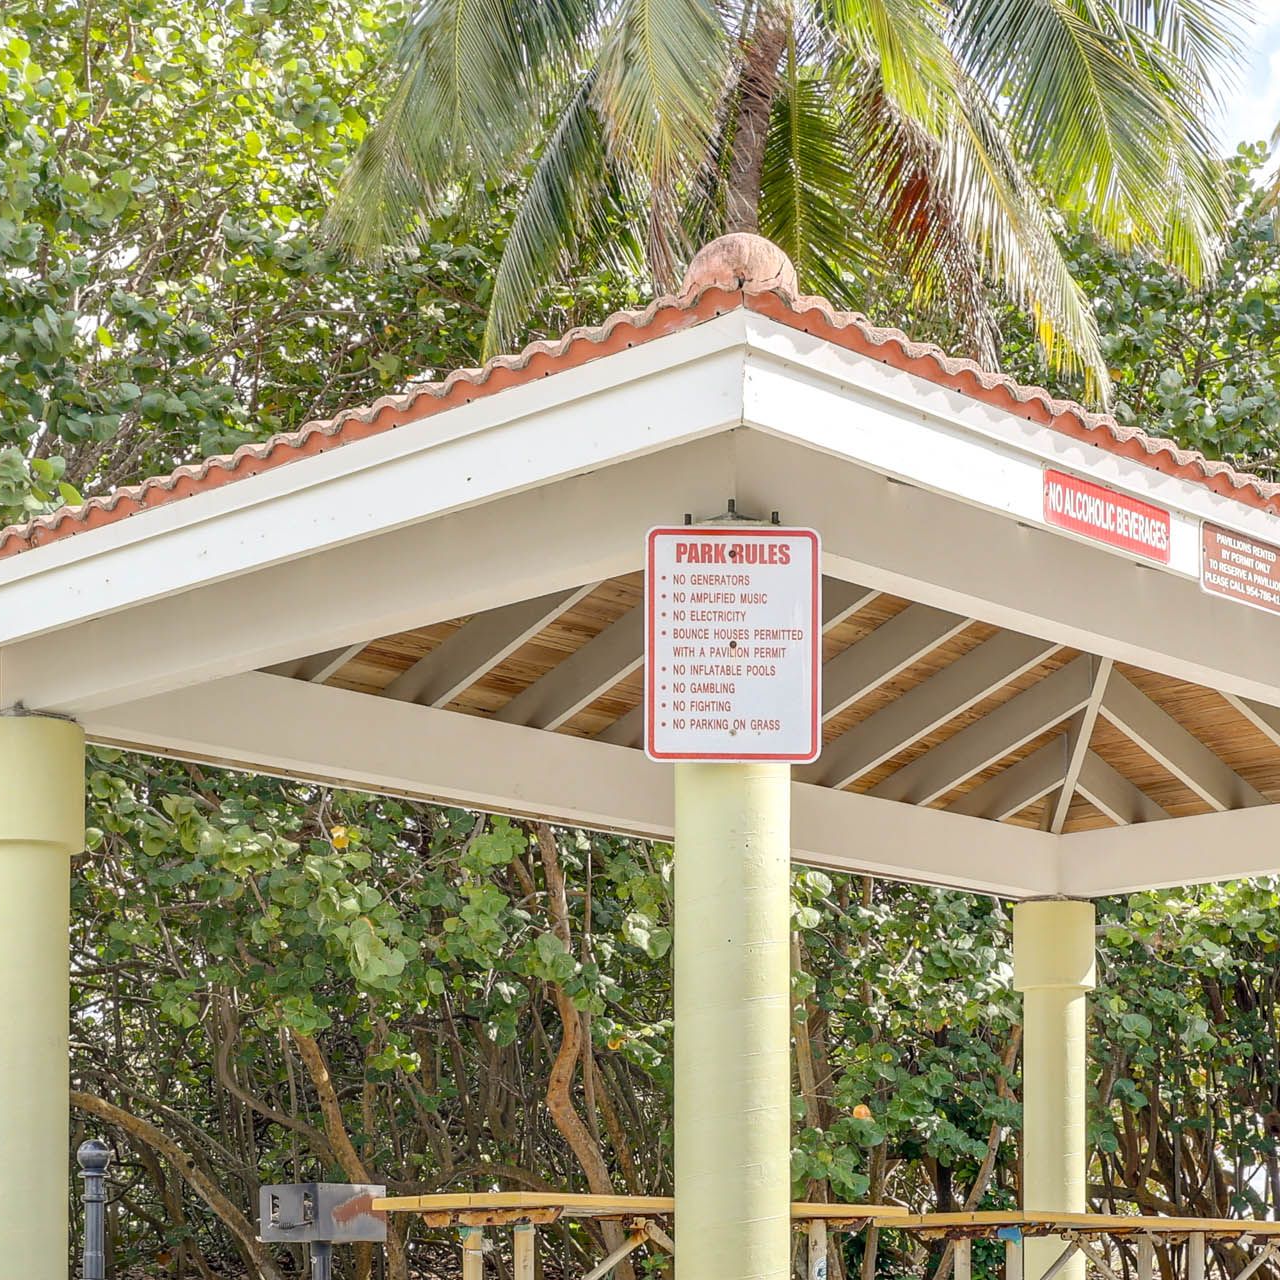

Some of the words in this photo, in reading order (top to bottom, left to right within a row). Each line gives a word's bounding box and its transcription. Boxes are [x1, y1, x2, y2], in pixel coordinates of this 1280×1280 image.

[1049, 482, 1063, 512] NO
[1064, 488, 1115, 532] ALCOHOLIC
[1117, 506, 1167, 551] BEVERAGES
[1216, 533, 1252, 553] PAVILLIONS
[1252, 546, 1276, 562] RENTED
[676, 543, 726, 563] PARK
[733, 544, 790, 564] RULES
[1221, 549, 1231, 560] BY
[1231, 553, 1254, 568] PERMIT
[1255, 561, 1271, 573] ONLY
[1209, 559, 1218, 569] TO
[1219, 562, 1248, 580] RESERVE
[1248, 572, 1253, 581] A
[673, 575, 686, 584] NO
[690, 575, 750, 585] GENERATORS
[1205, 572, 1229, 588] PLEASE
[1230, 580, 1245, 593] CALL
[673, 593, 686, 603] NO
[690, 593, 736, 604] AMPLIFIED
[740, 594, 767, 604] MUSIC
[673, 611, 686, 621] NO
[691, 611, 746, 622] ELECTRICITY
[673, 629, 709, 639] BOUNCE
[714, 629, 750, 640] HOUSES
[754, 630, 803, 640] PERMITTED
[673, 647, 695, 657] WITH
[699, 647, 705, 657] A
[710, 647, 750, 658] PAVILION
[754, 648, 787, 658] PERMIT
[673, 665, 686, 675] NO
[690, 665, 742, 676] INFLATABLE
[746, 666, 776, 676] POOLS
[673, 683, 686, 693] NO
[690, 683, 735, 693] GAMBLING
[673, 701, 686, 711] NO
[690, 701, 731, 712] FIGHTING
[673, 720, 686, 729] NO
[690, 720, 729, 730] PARKING
[733, 720, 746, 730] ON
[751, 720, 780, 730] GRASS
